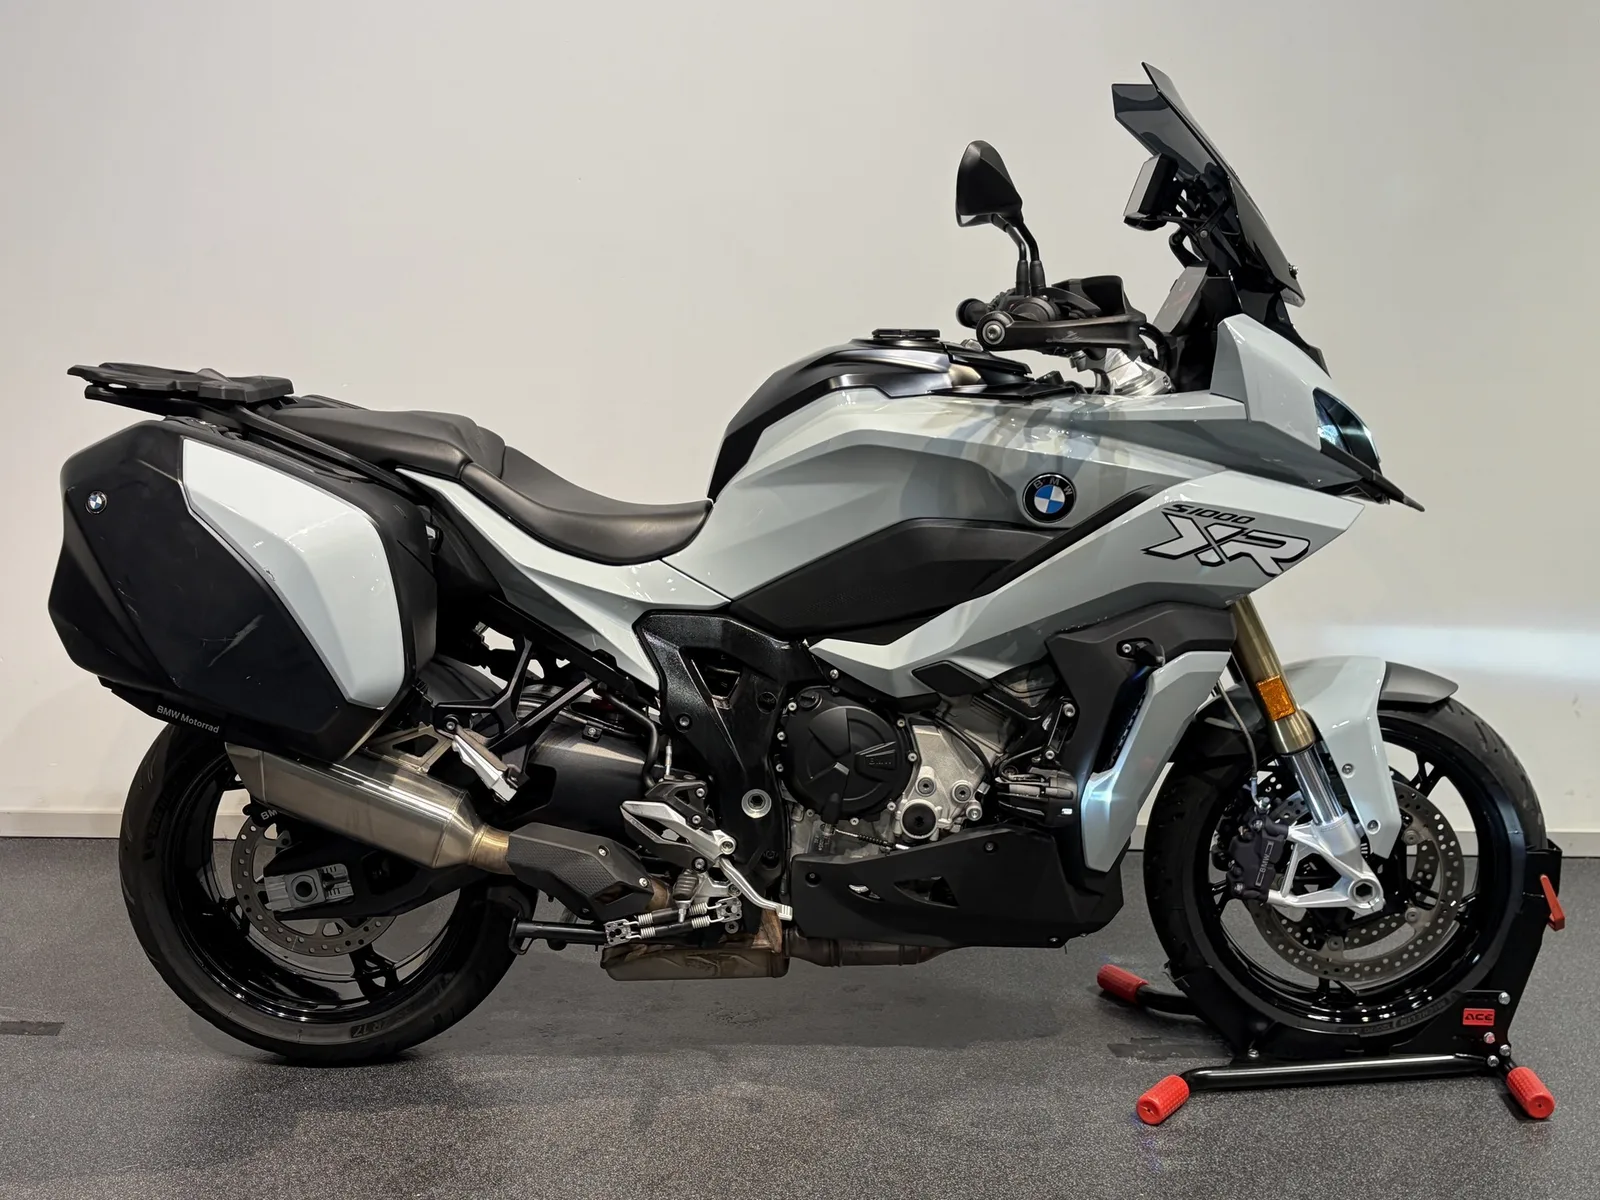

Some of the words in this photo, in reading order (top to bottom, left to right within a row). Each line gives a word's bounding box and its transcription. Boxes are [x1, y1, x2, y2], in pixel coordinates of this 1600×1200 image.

[1033, 477, 1073, 496] BMW
[1163, 503, 1255, 525] S1000
[1141, 511, 1311, 577] XR
[156, 704, 181, 719] BMW
[180, 713, 220, 734] Motorrad
[260, 809, 278, 820] BM
[1259, 853, 1271, 873] BMW
[1464, 1013, 1494, 1022] ACE
